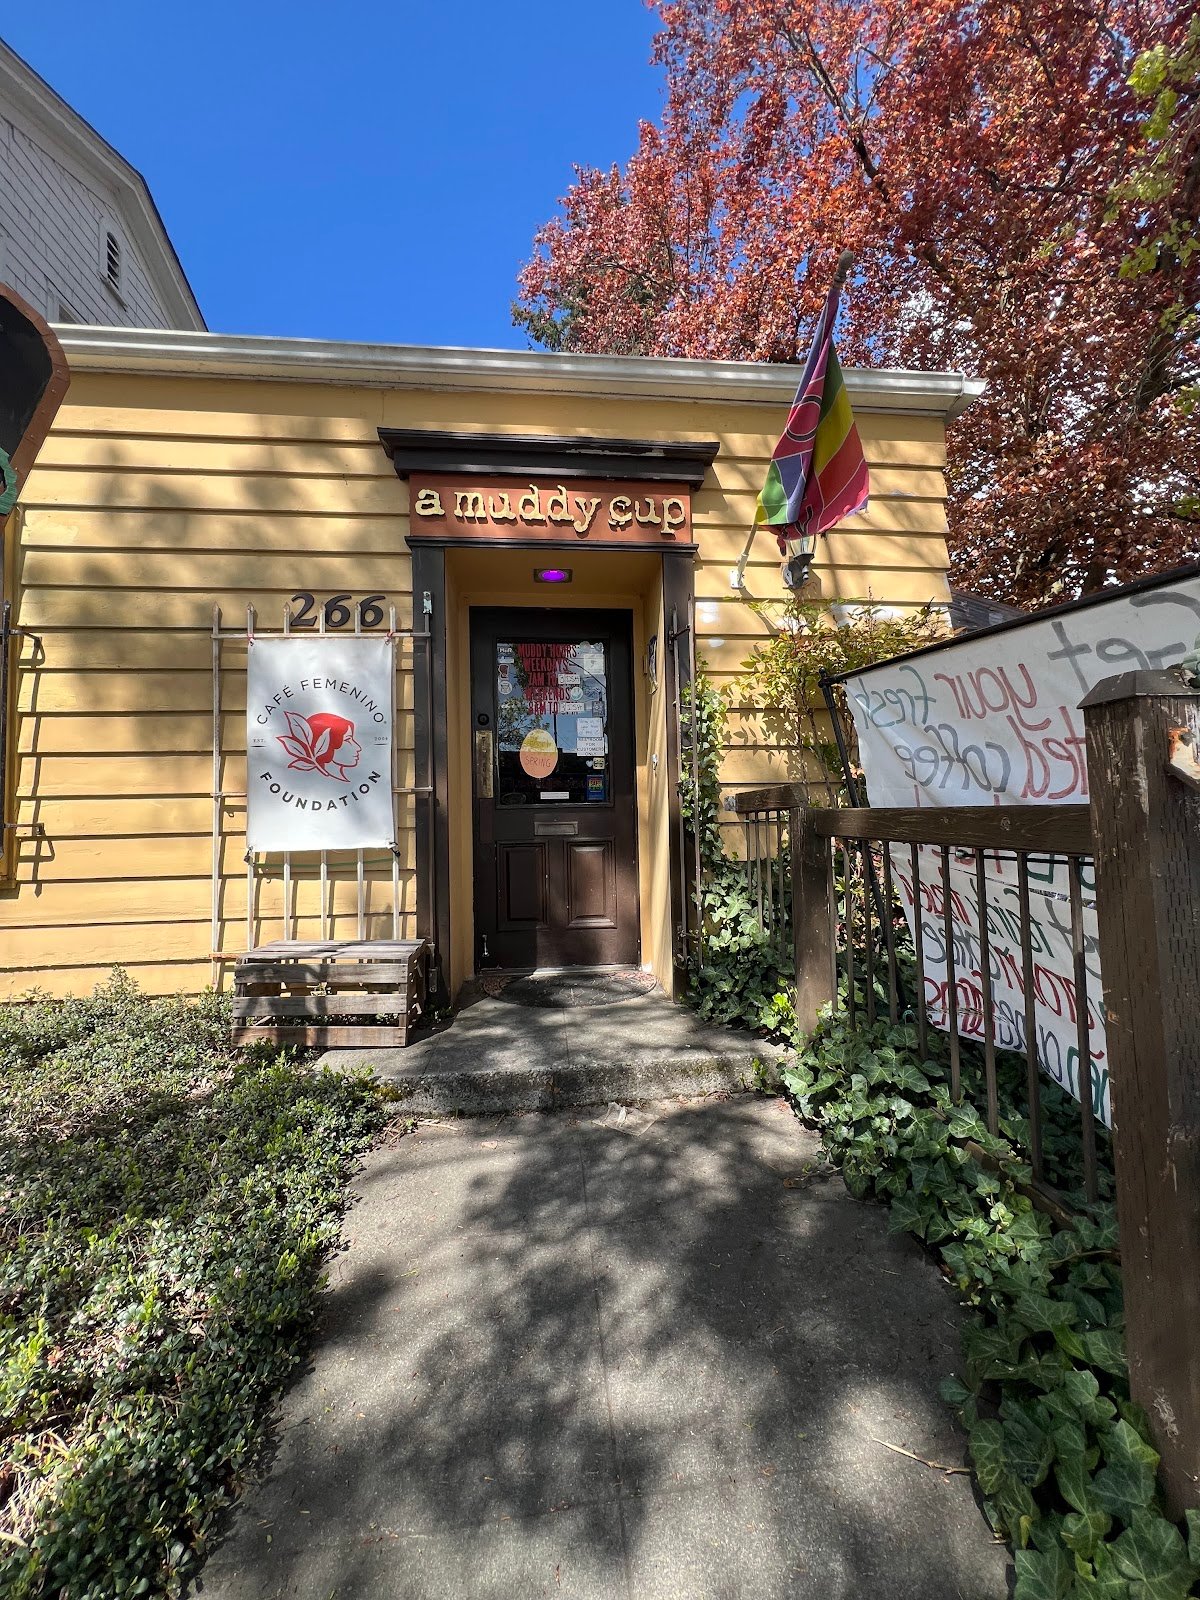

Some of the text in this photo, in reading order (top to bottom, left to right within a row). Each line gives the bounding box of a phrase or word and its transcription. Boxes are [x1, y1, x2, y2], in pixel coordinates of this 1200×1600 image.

[415, 484, 686, 534] a muddy cup
[290, 592, 386, 628] 266
[518, 644, 547, 657] MUDDY
[256, 678, 384, 725] CAFÉ FEMENINO
[526, 756, 551, 768] SPRING
[260, 771, 382, 811] FOUNDATION
